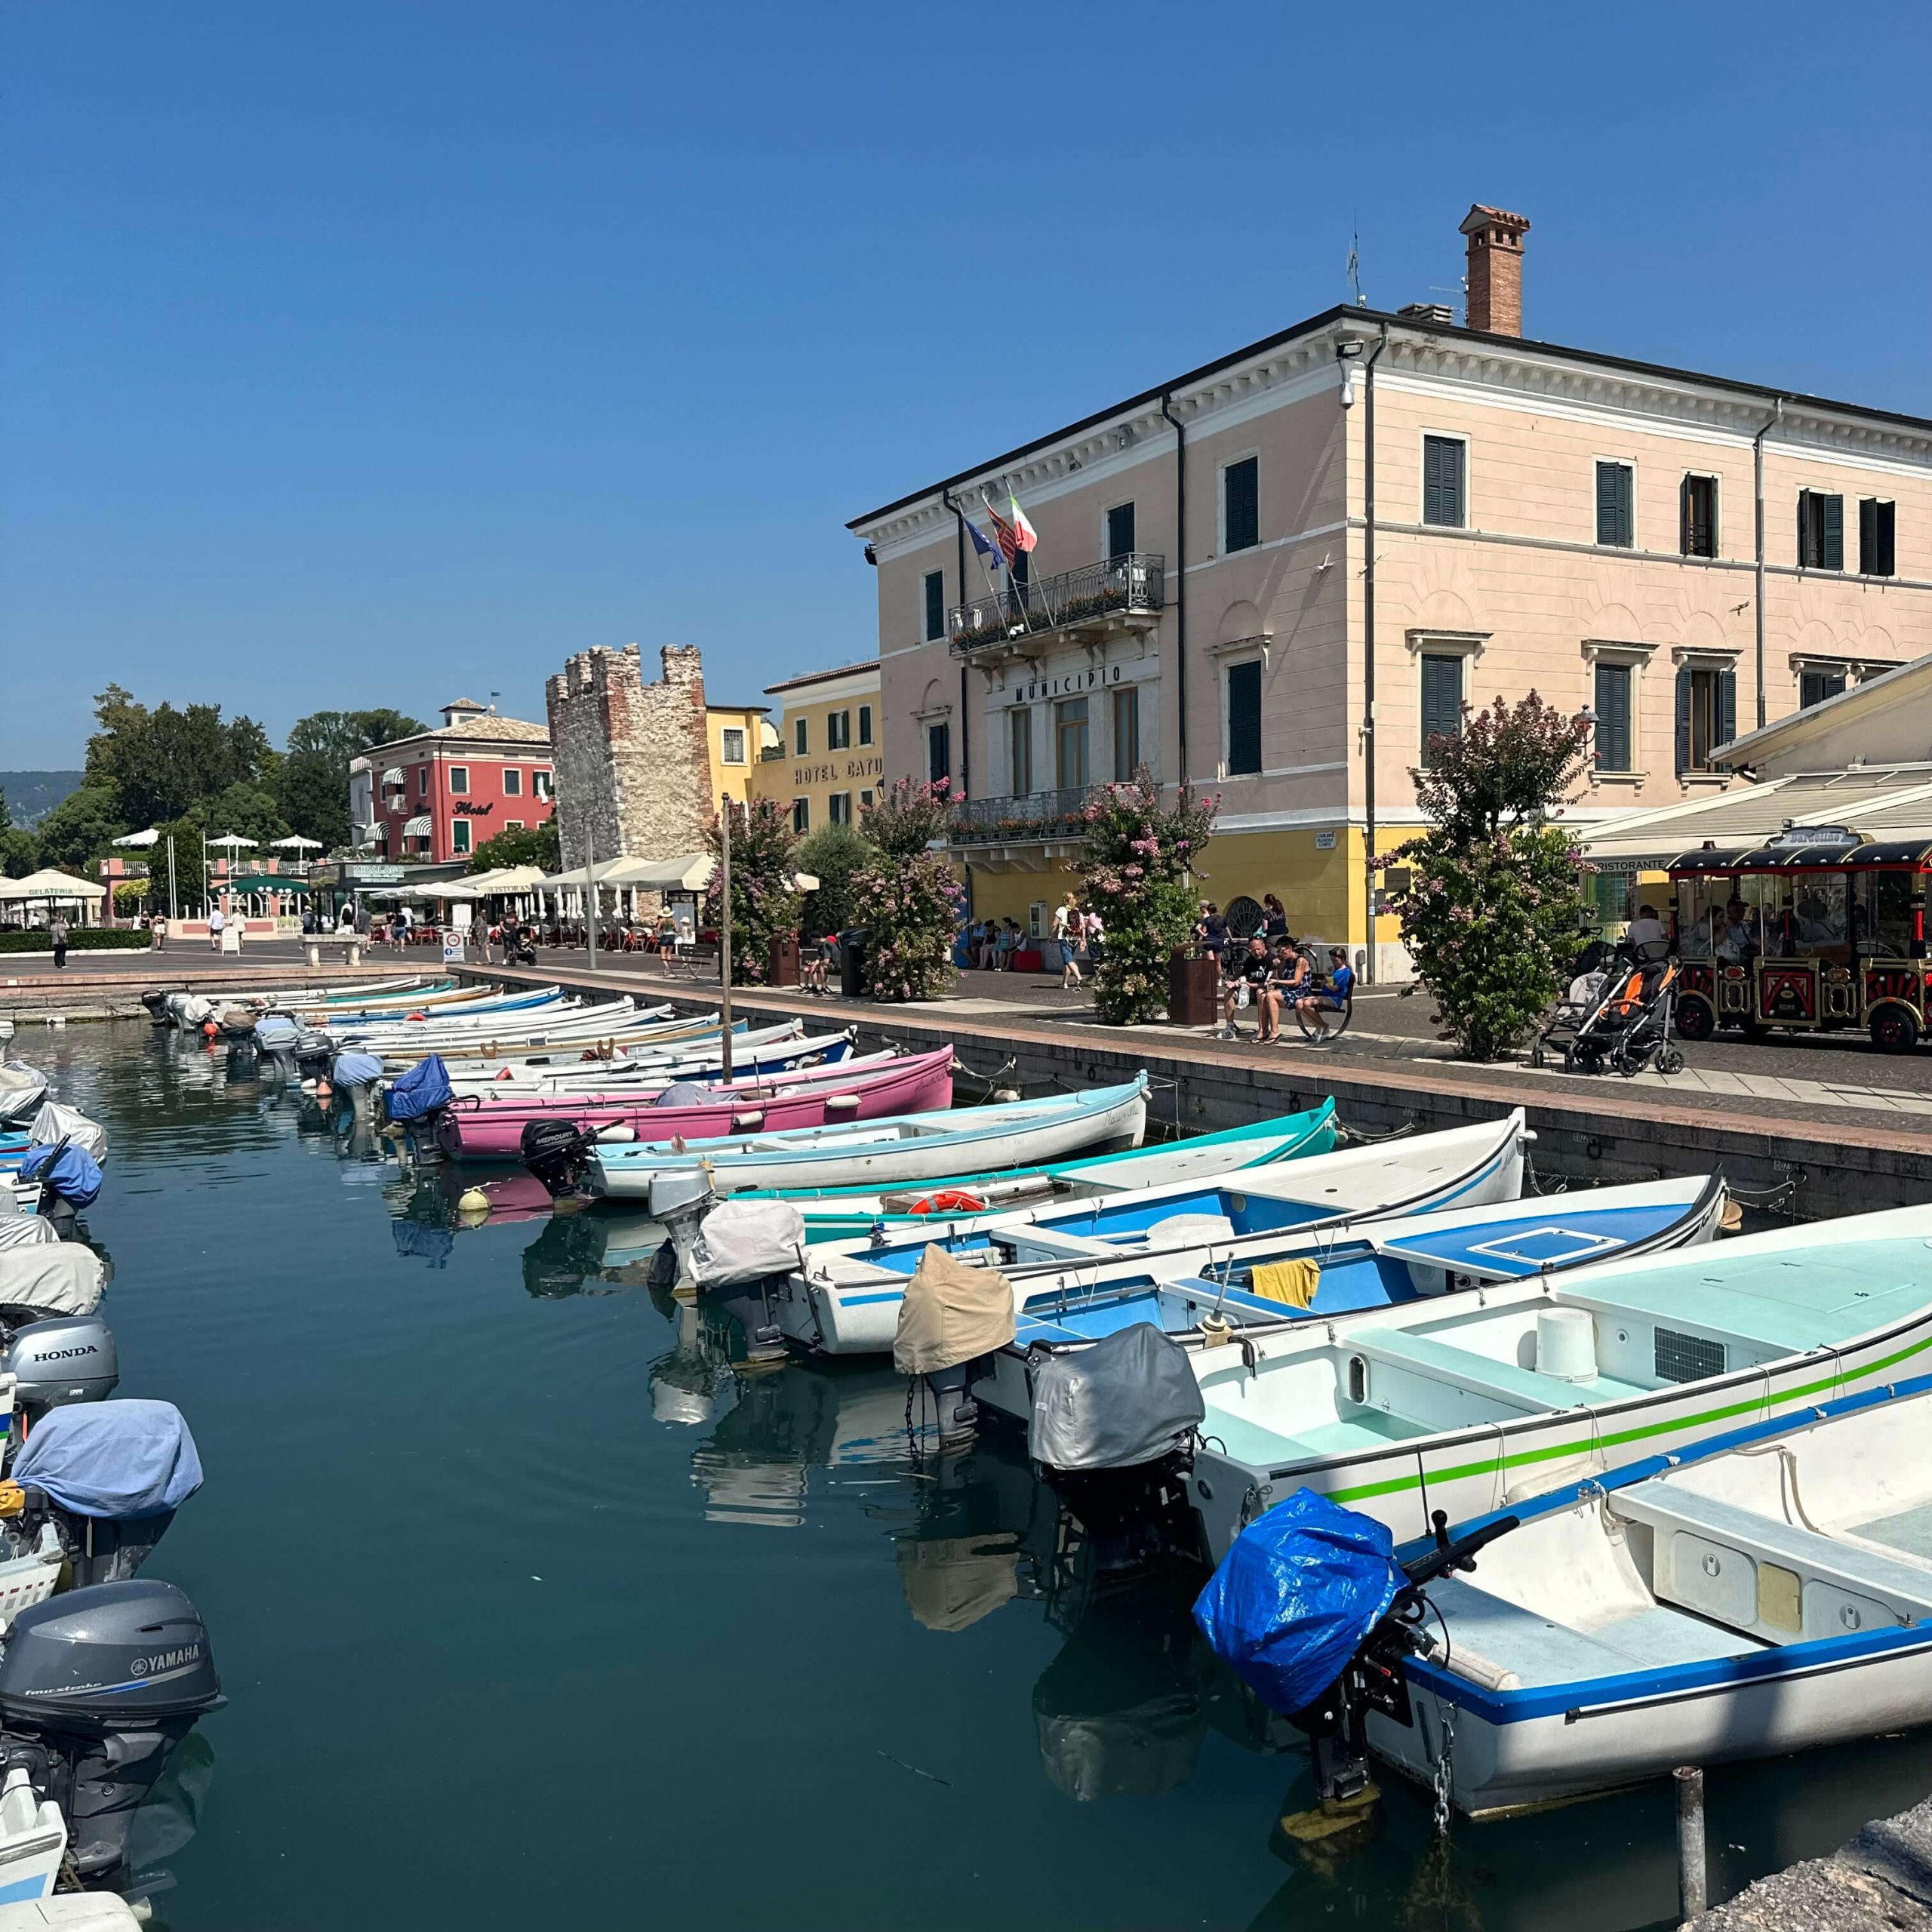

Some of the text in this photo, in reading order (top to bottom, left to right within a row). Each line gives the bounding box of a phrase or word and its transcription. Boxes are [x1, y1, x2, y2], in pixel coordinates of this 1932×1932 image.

[1016, 666, 1120, 702] MUNICIPIO
[795, 758, 883, 785] HOTEL CATU
[453, 801, 494, 815] Hotel
[1598, 860, 1665, 871] RISTORANTE
[536, 1131, 574, 1145] MERCURY
[33, 1345, 99, 1362] HONDA
[149, 1644, 199, 1672] YAMAHA
